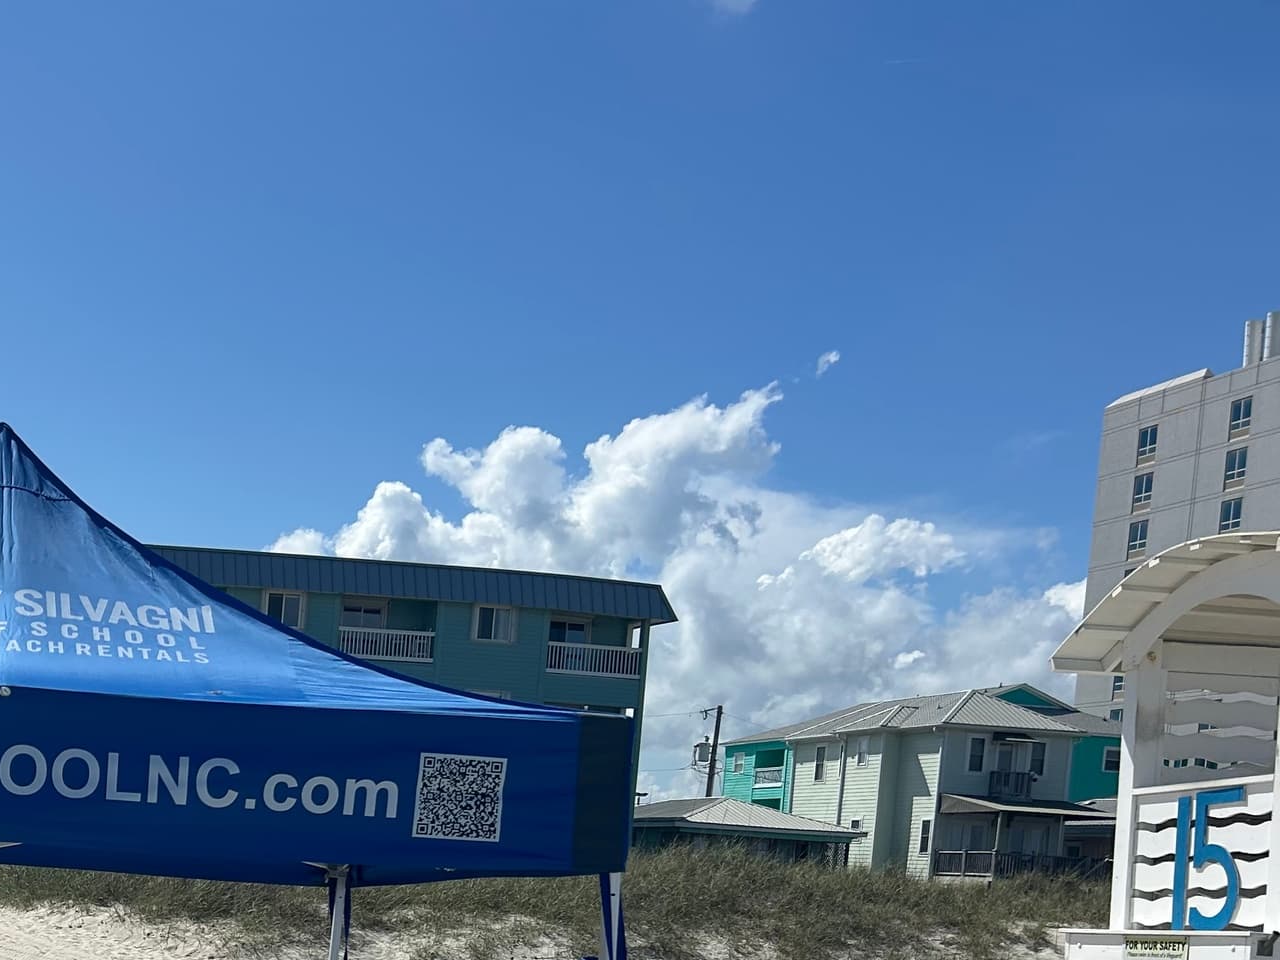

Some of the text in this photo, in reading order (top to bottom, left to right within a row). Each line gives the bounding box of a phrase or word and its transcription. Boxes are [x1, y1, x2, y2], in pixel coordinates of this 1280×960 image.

[14, 589, 216, 633] SILVAGNI
[30, 621, 206, 650] SCHOOL
[75, 643, 210, 664] RENTALS
[1172, 786, 1245, 931] 15
[1125, 940, 1187, 952] FOR YOUR SAFETY
